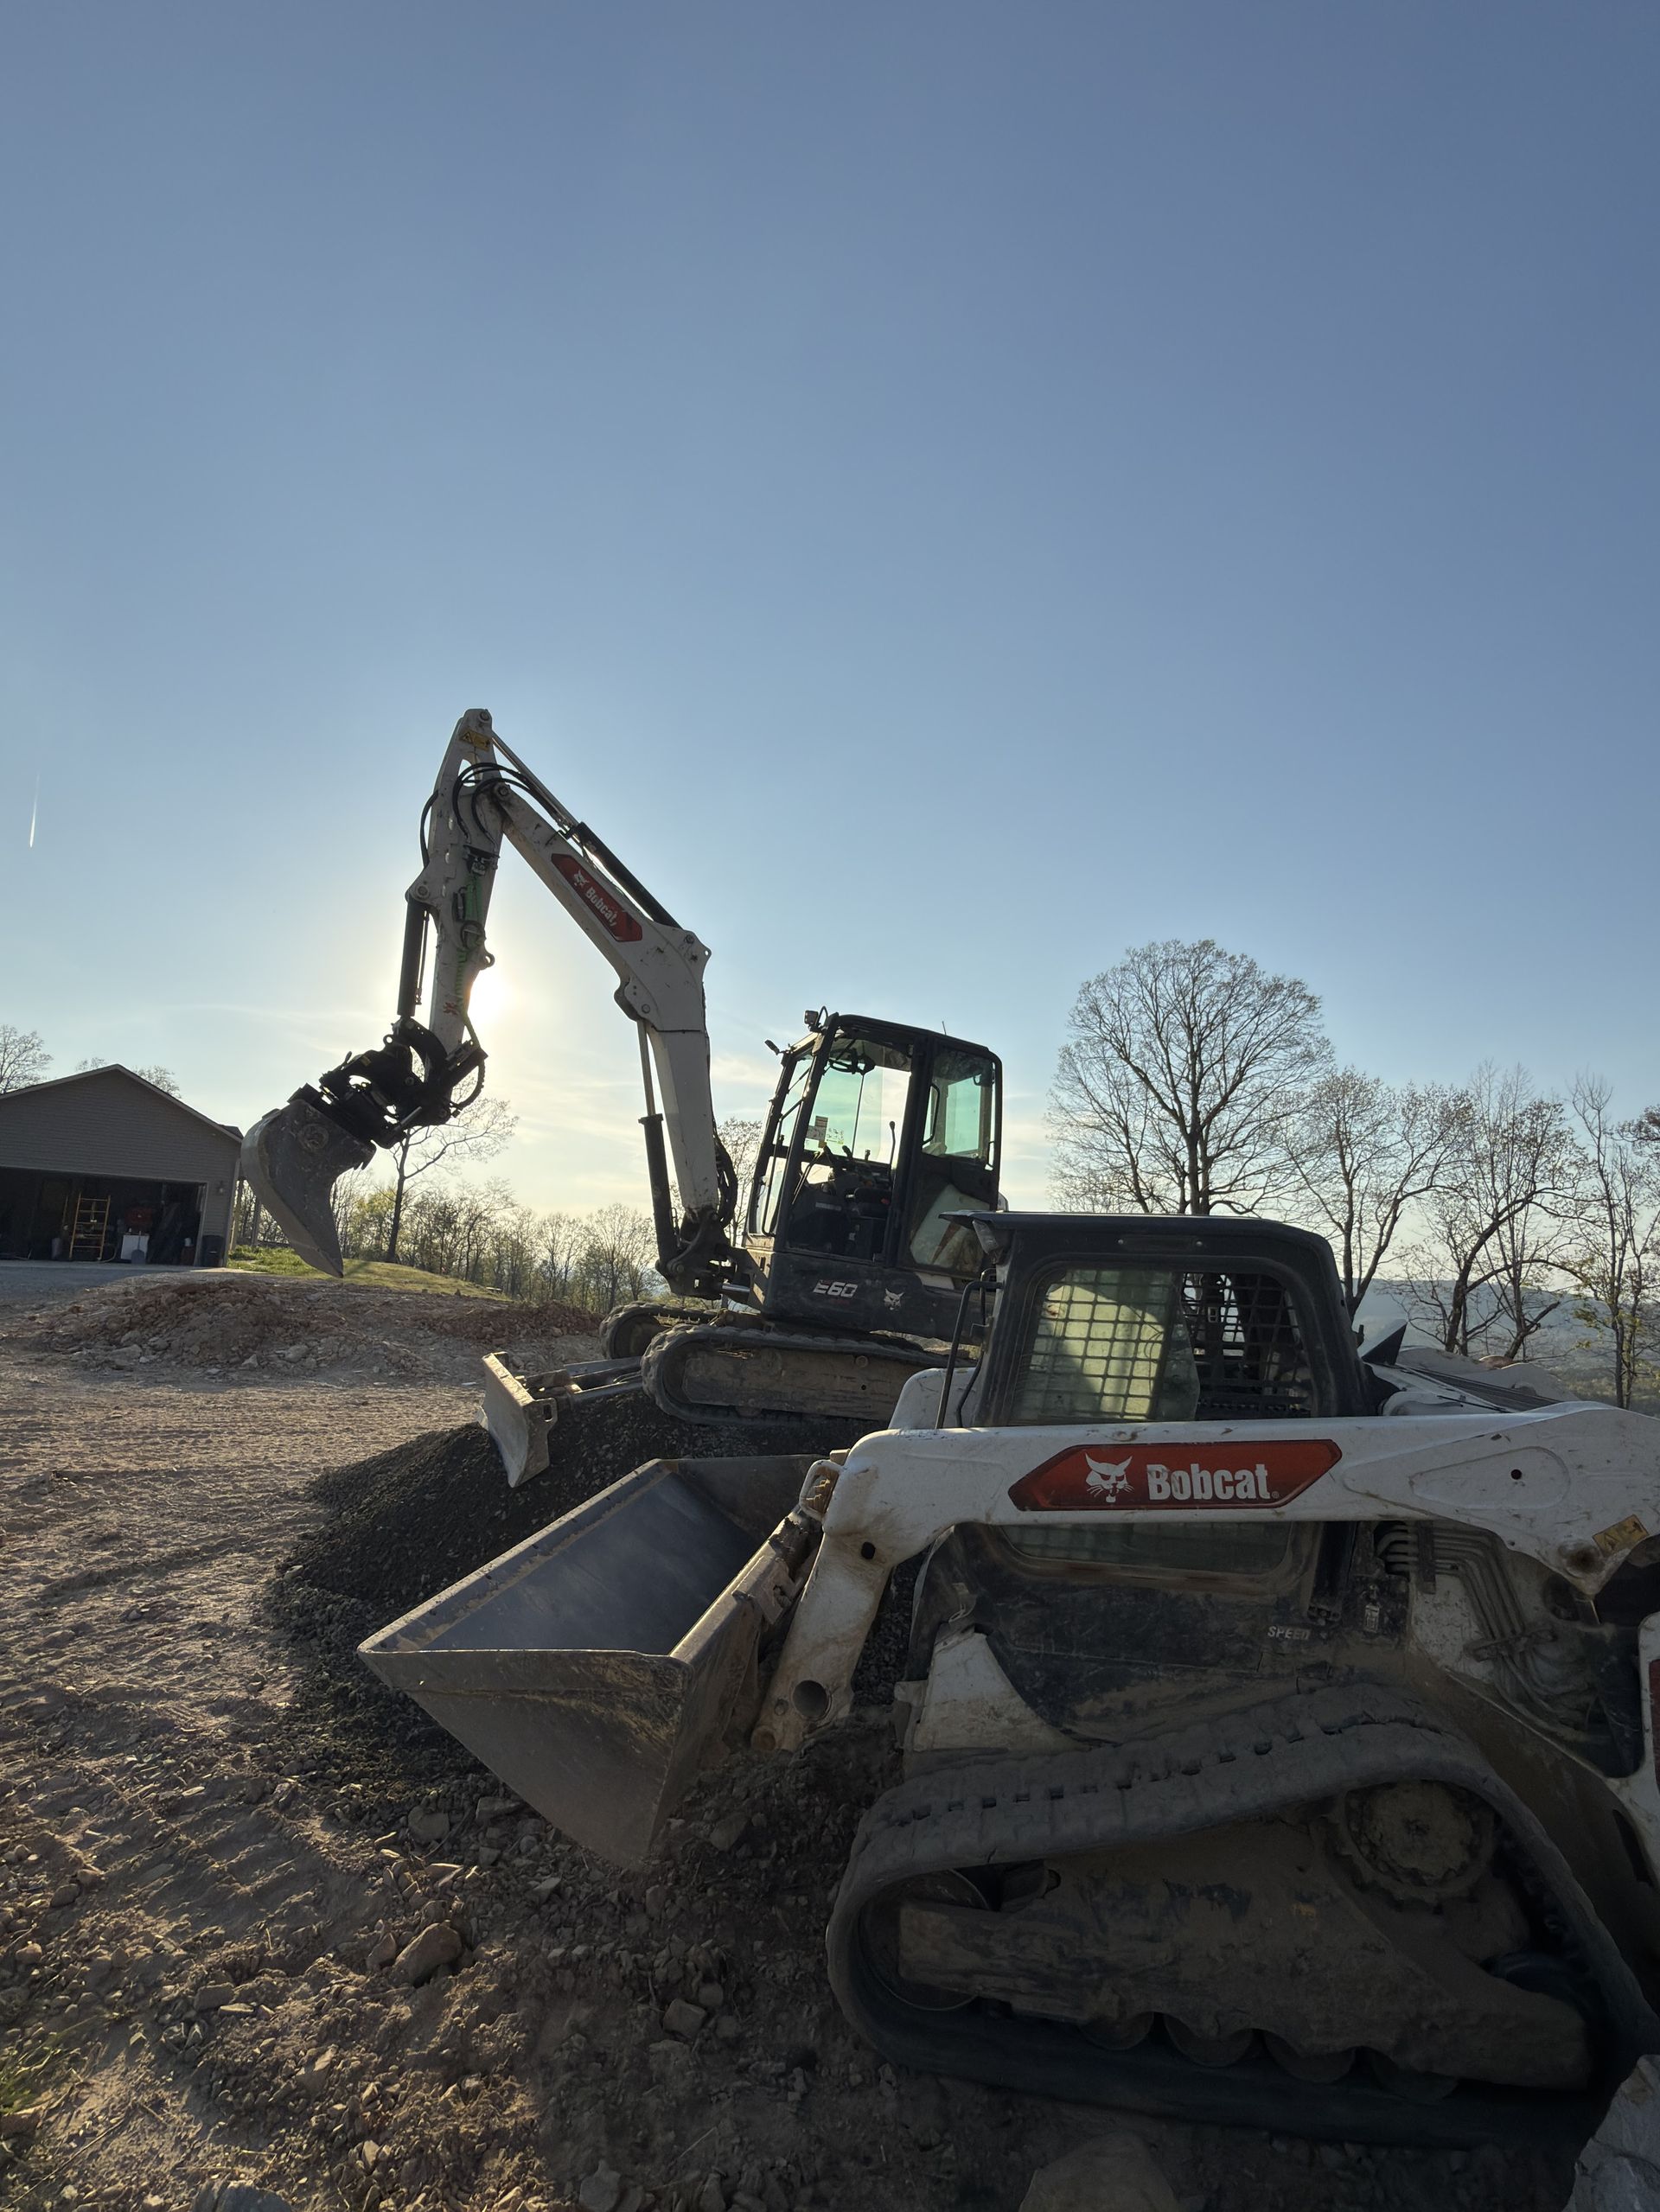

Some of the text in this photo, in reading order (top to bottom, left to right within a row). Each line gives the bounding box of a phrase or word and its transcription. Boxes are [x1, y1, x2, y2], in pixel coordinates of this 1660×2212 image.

[585, 887, 617, 927] Bobcat
[813, 1280, 858, 1297] E60
[1146, 1463, 1271, 1501] Bobcat
